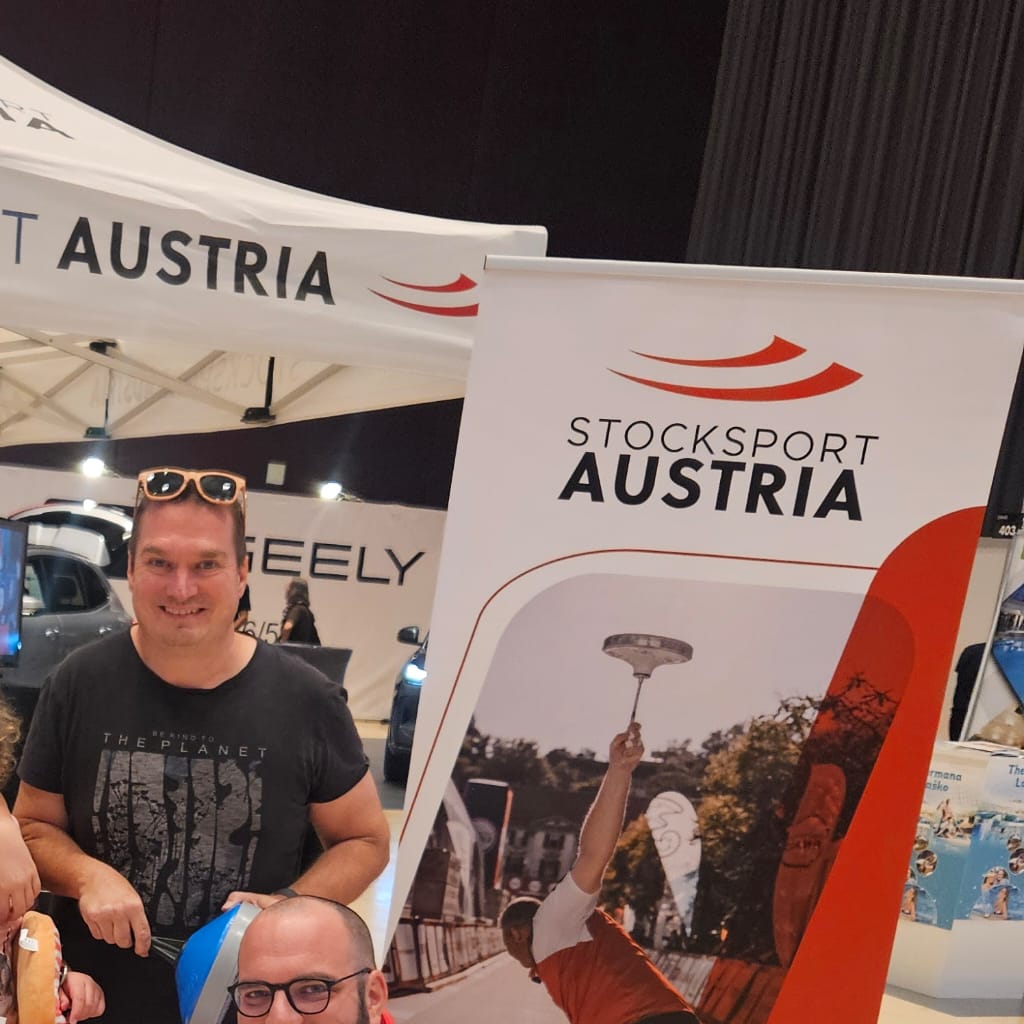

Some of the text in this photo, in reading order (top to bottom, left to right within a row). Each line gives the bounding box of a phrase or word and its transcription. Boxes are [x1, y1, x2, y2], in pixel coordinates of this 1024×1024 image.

[56, 216, 336, 305] AUSTRIA
[567, 417, 879, 465] STOCKSPORT
[558, 451, 862, 521] AUSTRIA
[998, 525, 1016, 536] 403
[103, 733, 267, 759] THE PLANET
[928, 770, 962, 782] rmana
